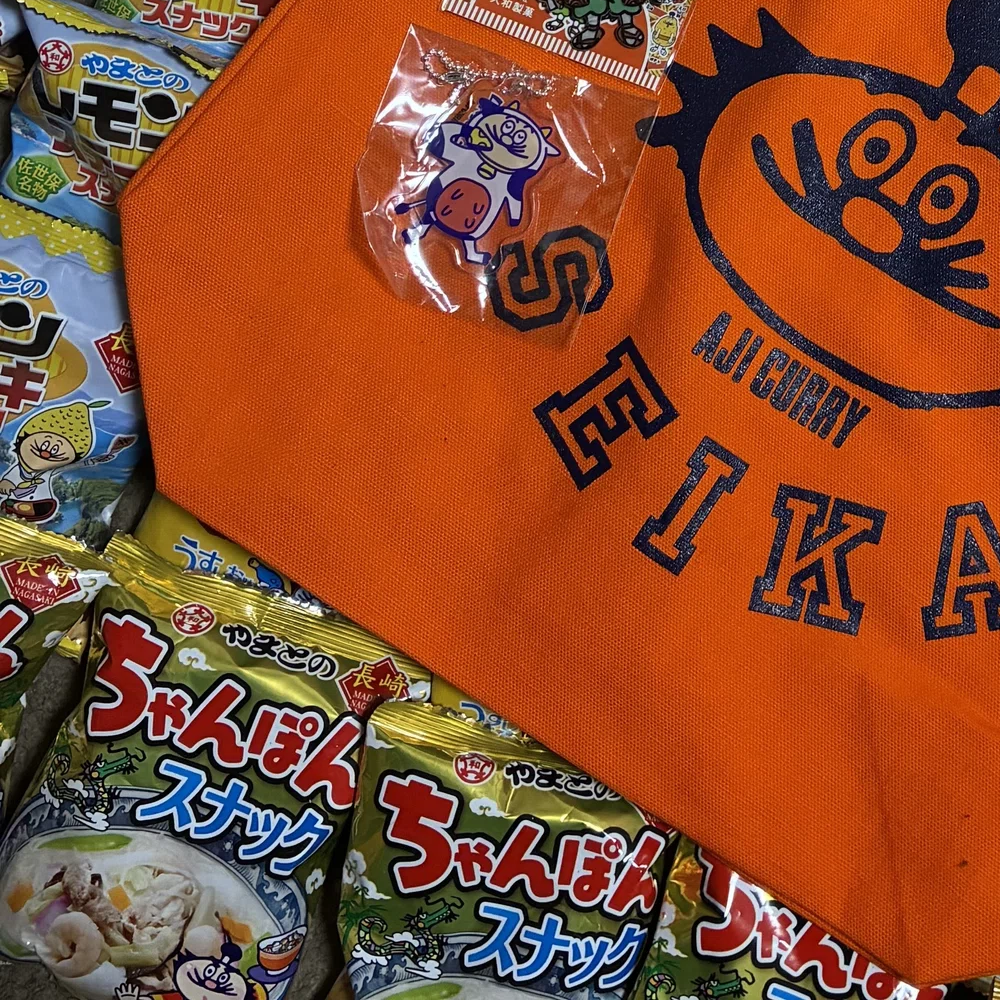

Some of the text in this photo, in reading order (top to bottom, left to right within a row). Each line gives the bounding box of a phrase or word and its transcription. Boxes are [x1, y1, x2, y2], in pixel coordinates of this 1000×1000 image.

[81, 53, 191, 93] やまとの
[17, 174, 49, 202] 名物
[18, 156, 64, 193] 佐世保
[691, 310, 871, 449] AJI CURRY
[221, 623, 338, 679] やまとの
[353, 663, 408, 698] 長崎
[87, 611, 365, 811] ちゃんぽん
[136, 759, 334, 877] スナック
[381, 774, 667, 916] ちゃんぽん
[464, 902, 648, 988] スナック
